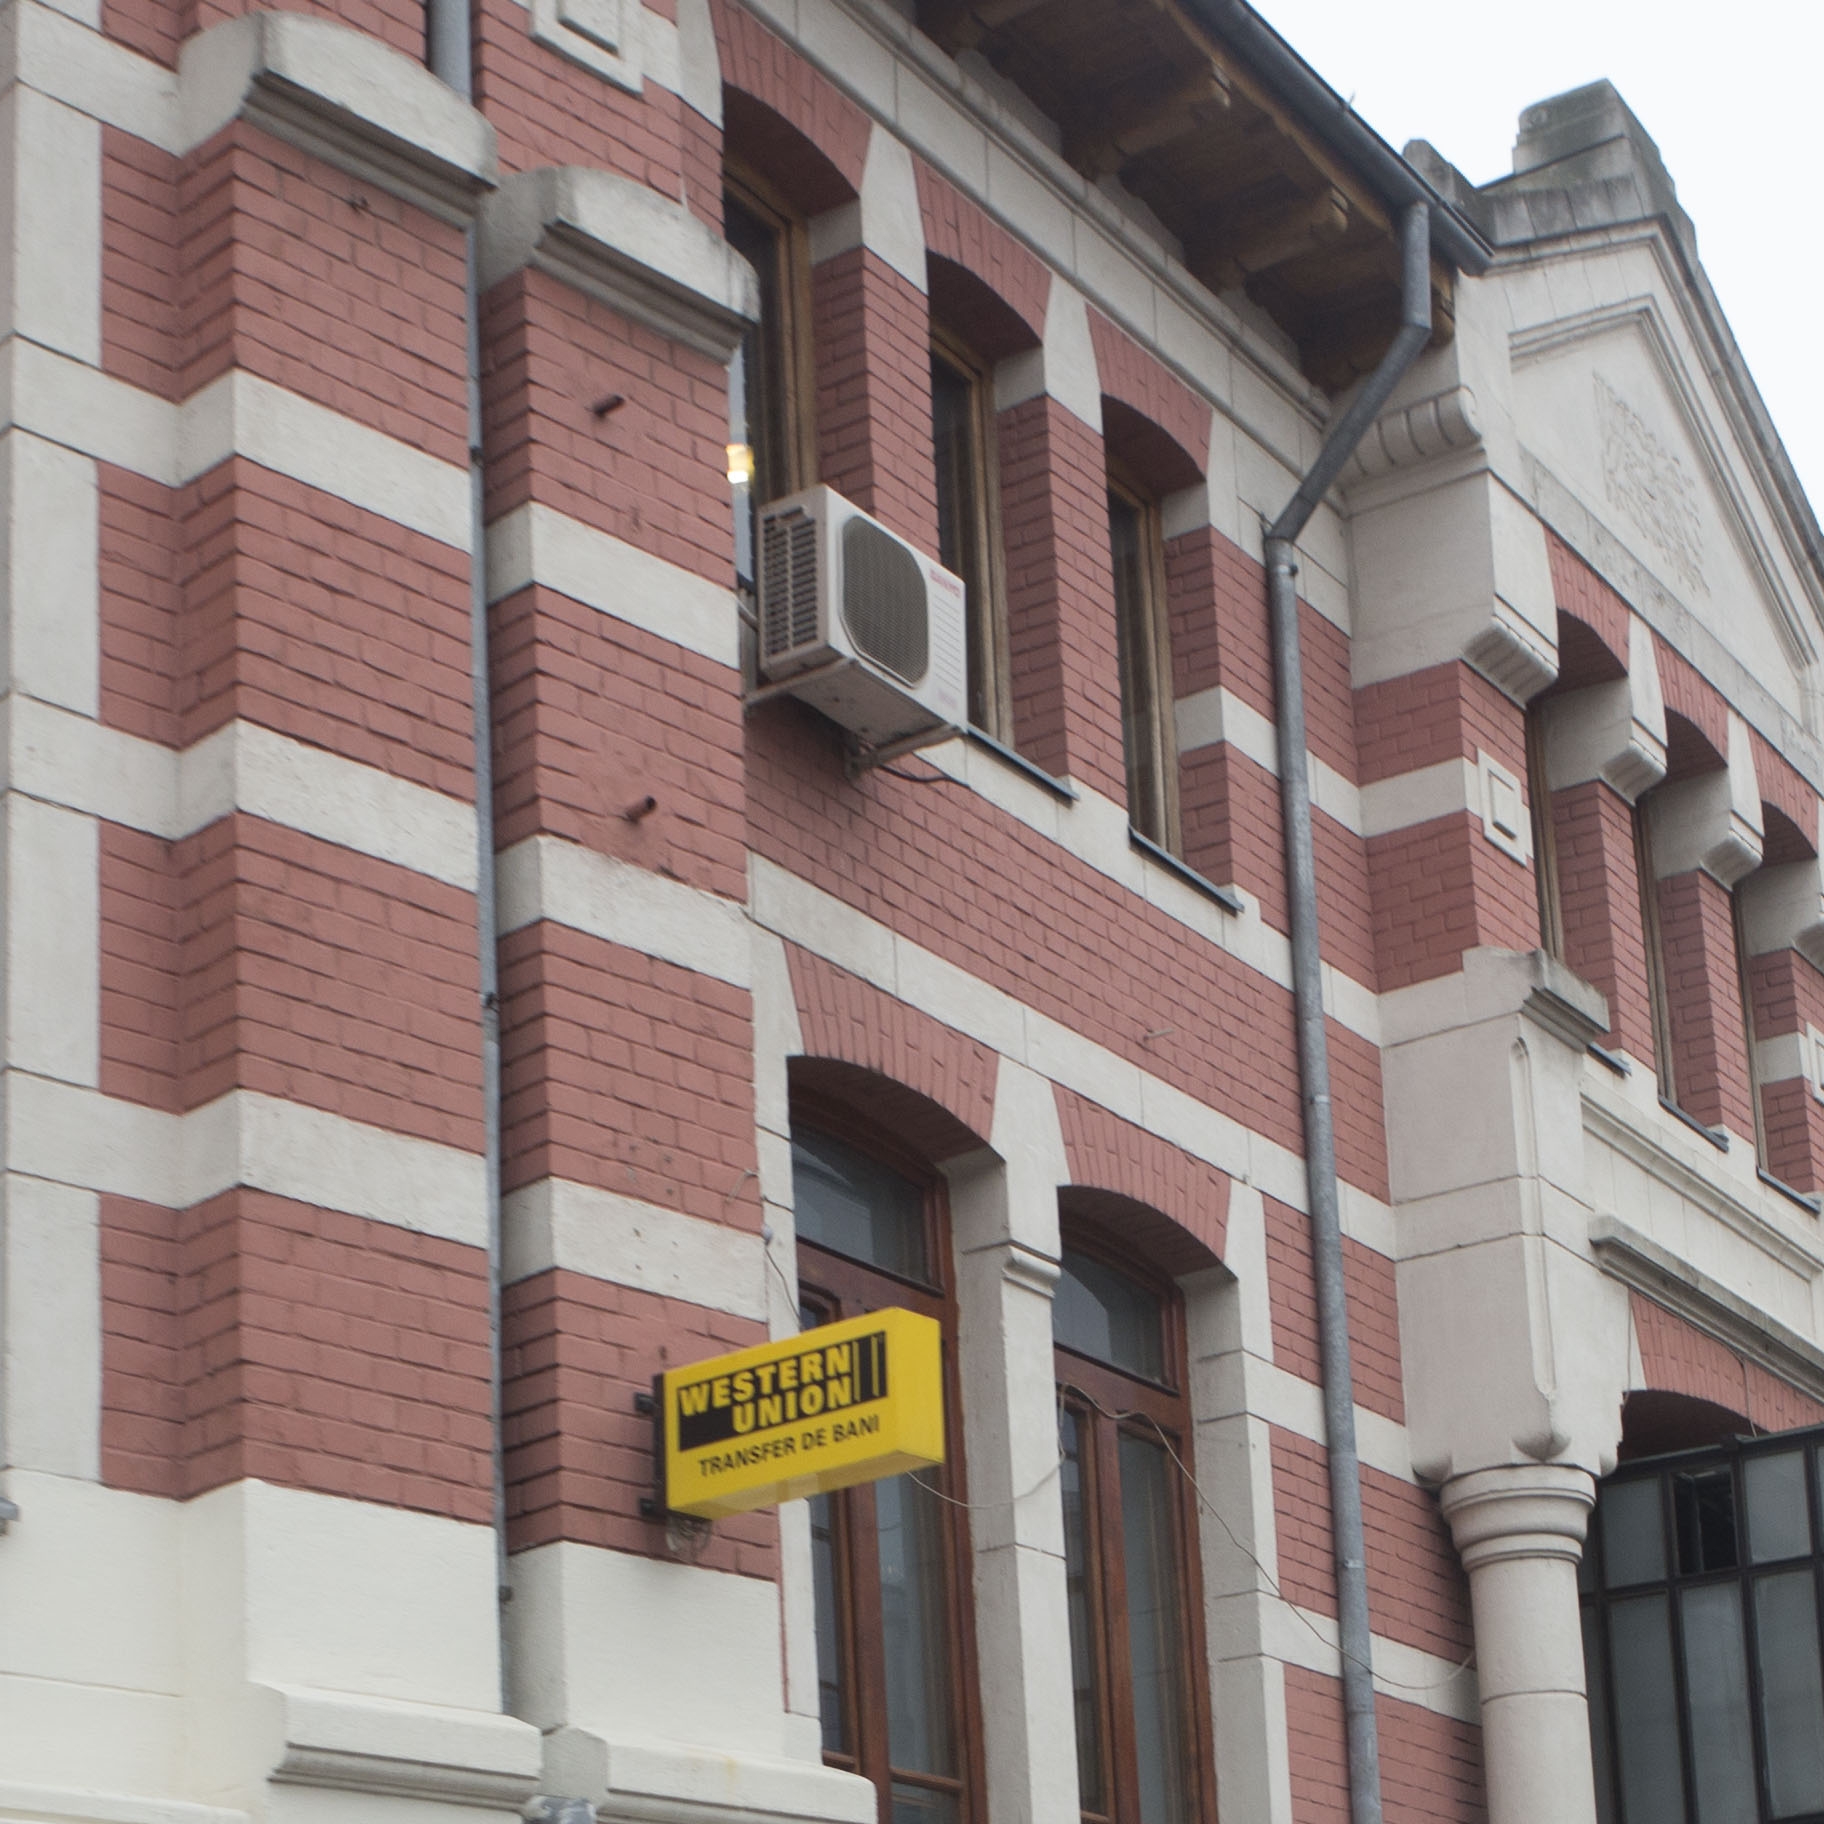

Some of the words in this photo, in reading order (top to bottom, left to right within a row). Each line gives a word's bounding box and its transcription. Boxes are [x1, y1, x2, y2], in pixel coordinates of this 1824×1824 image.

[679, 1343, 851, 1417] WESTERN
[732, 1375, 853, 1434] UNION
[698, 1436, 797, 1477] TRANSFER
[801, 1428, 828, 1451] DE
[832, 1414, 881, 1443] BANI
